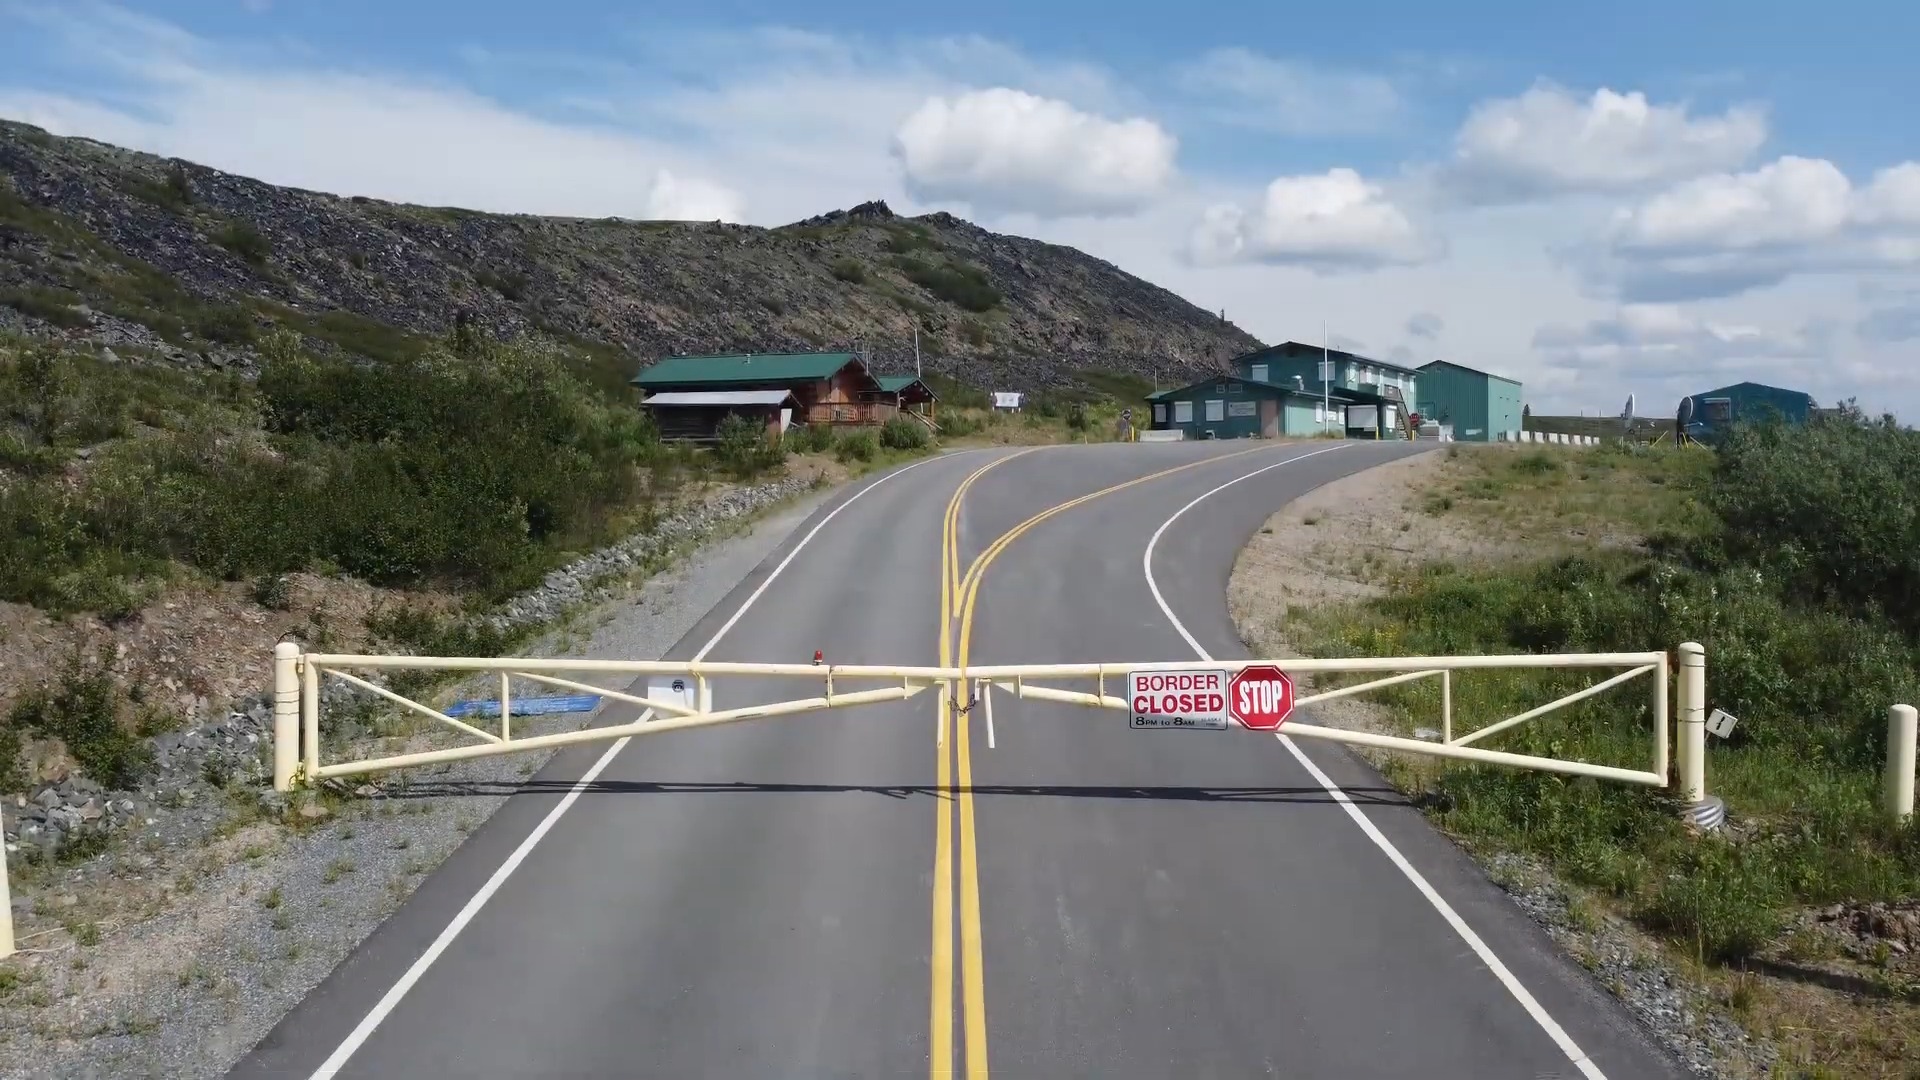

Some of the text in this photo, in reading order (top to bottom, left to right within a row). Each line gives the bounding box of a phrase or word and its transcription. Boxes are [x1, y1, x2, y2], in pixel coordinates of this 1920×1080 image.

[1136, 674, 1219, 692] BORDER
[1133, 694, 1224, 714] CLOSED
[1239, 680, 1283, 715] STOP
[1135, 716, 1158, 726] 8PM
[1161, 718, 1170, 726] to
[1173, 716, 1195, 726] 8AM
